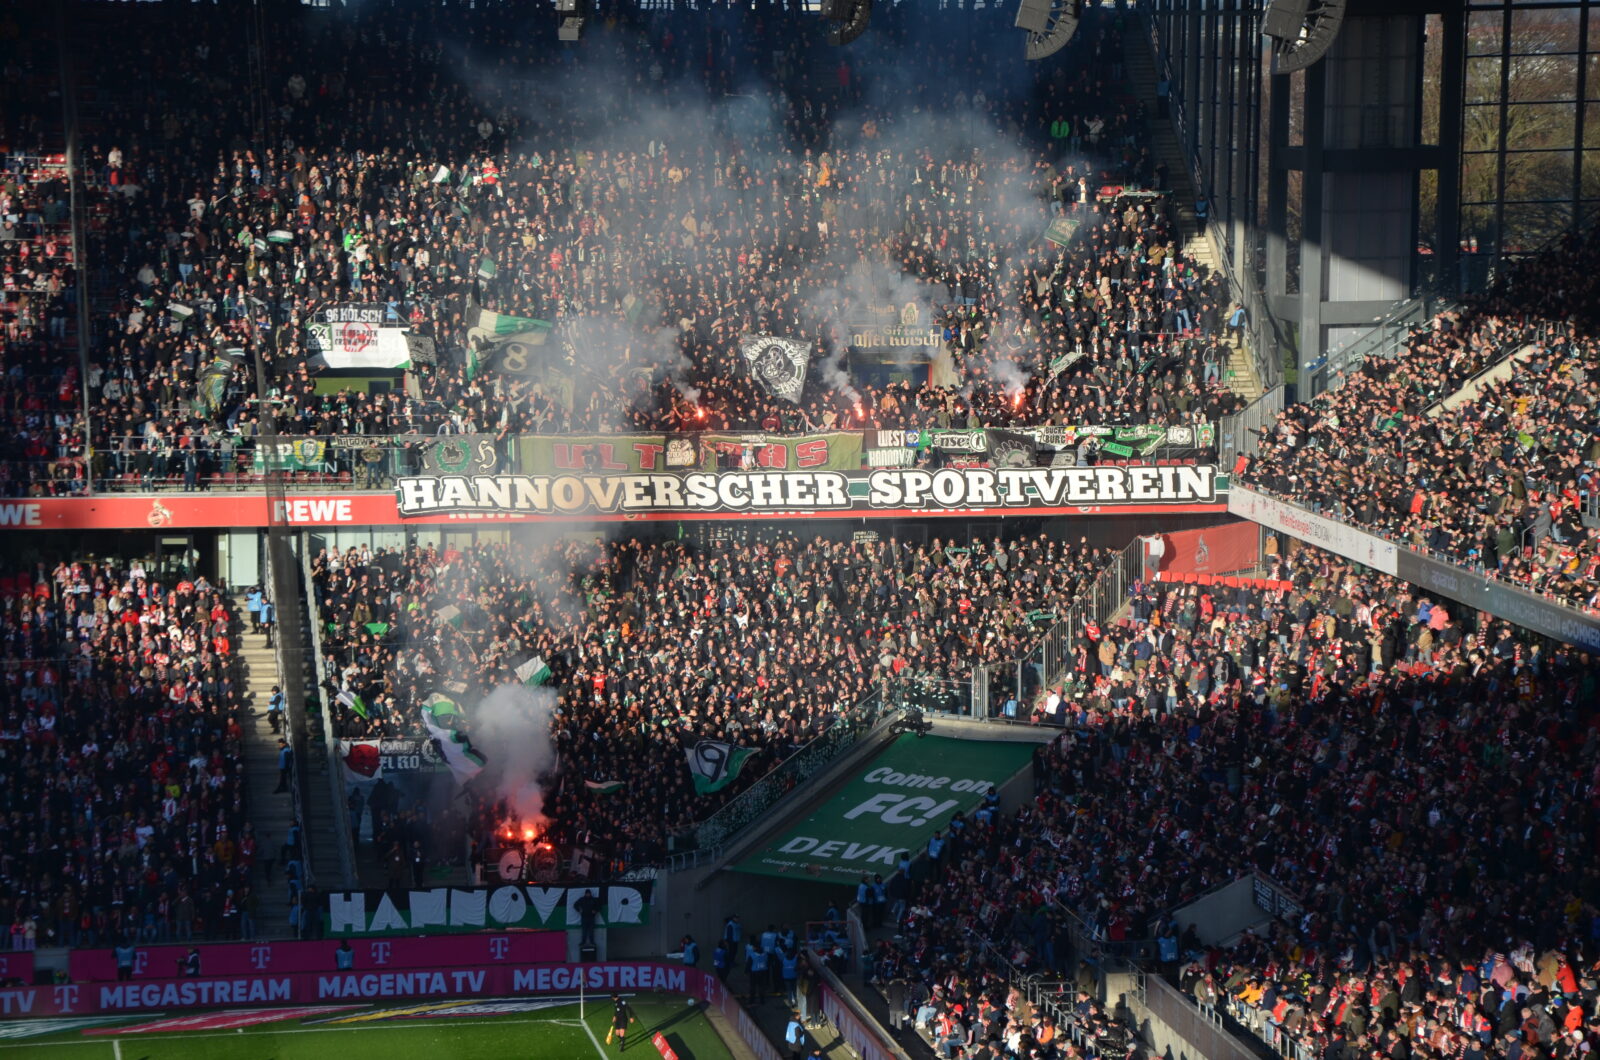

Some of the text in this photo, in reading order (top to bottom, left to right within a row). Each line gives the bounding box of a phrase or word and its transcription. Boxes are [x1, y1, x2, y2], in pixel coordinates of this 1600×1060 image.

[325, 304, 383, 323] 96 KÖLSCH
[878, 430, 905, 447] WEST
[399, 466, 1212, 512] HANNOVERSCHER SPORTVEREIN
[273, 499, 352, 522] REWE
[863, 767, 949, 789] Come
[843, 793, 959, 827] FC!
[778, 836, 910, 865] DEVK
[318, 970, 486, 999] MAGENTA TV
[513, 965, 686, 992] MEGASTREAM
[100, 978, 291, 1009] MEGASTREAM
